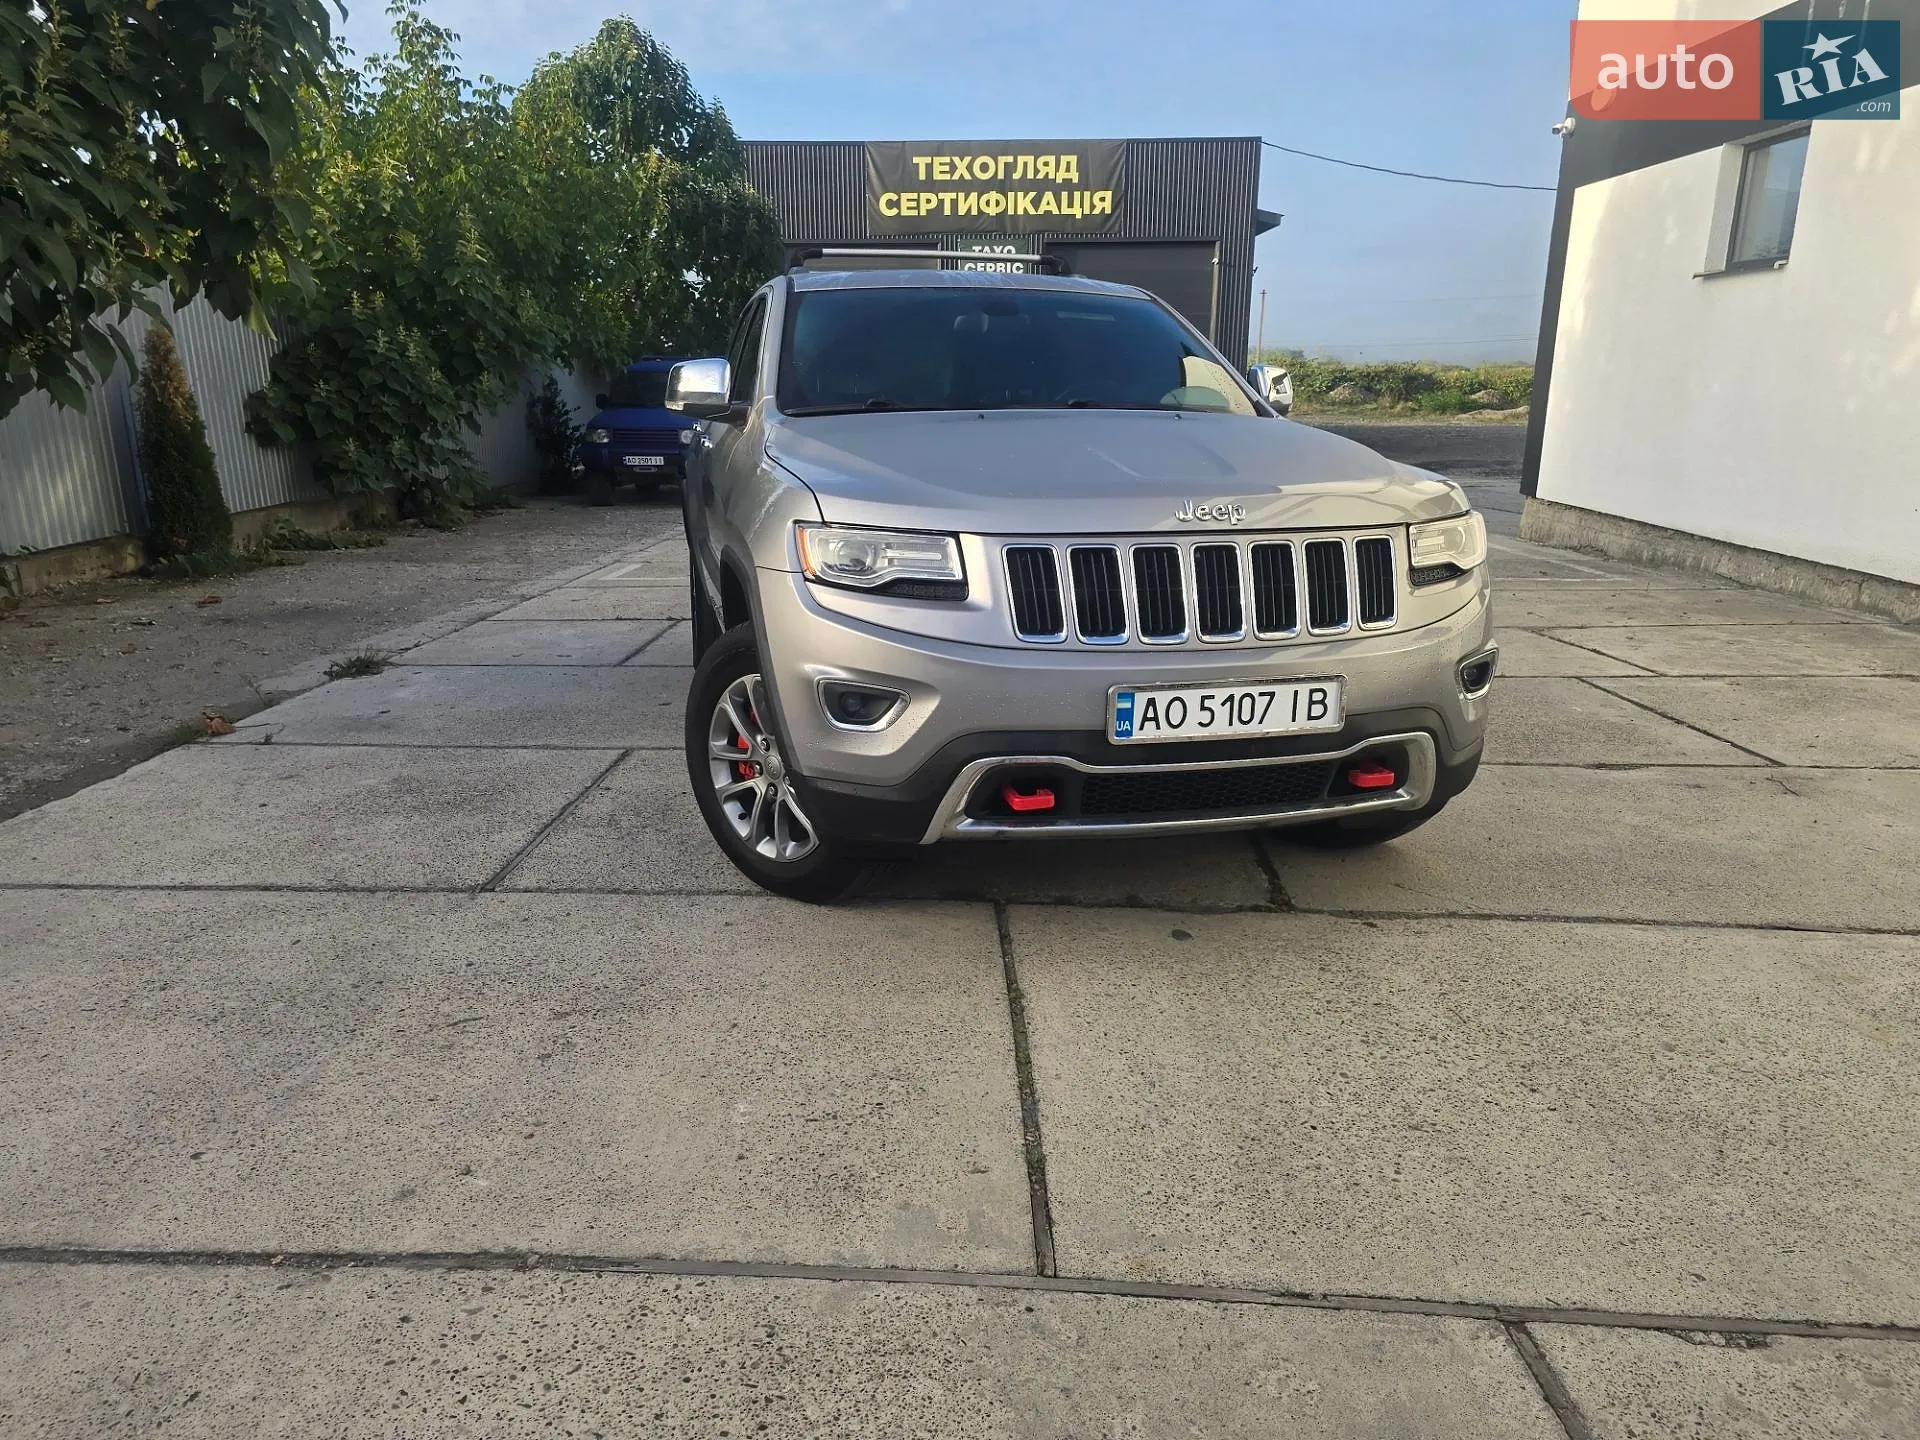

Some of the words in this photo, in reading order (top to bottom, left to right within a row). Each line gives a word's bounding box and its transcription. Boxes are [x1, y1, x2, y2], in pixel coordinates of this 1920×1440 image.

[912, 155, 1080, 184] ТЕХОГЛЯД
[878, 190, 1113, 219] СЕРТИФІКАЦІЯ
[1175, 496, 1246, 525] Jeep
[1138, 696, 1188, 731] AO
[1197, 691, 1276, 728] 5107
[1291, 687, 1329, 723] IB
[1116, 720, 1131, 731] UA
